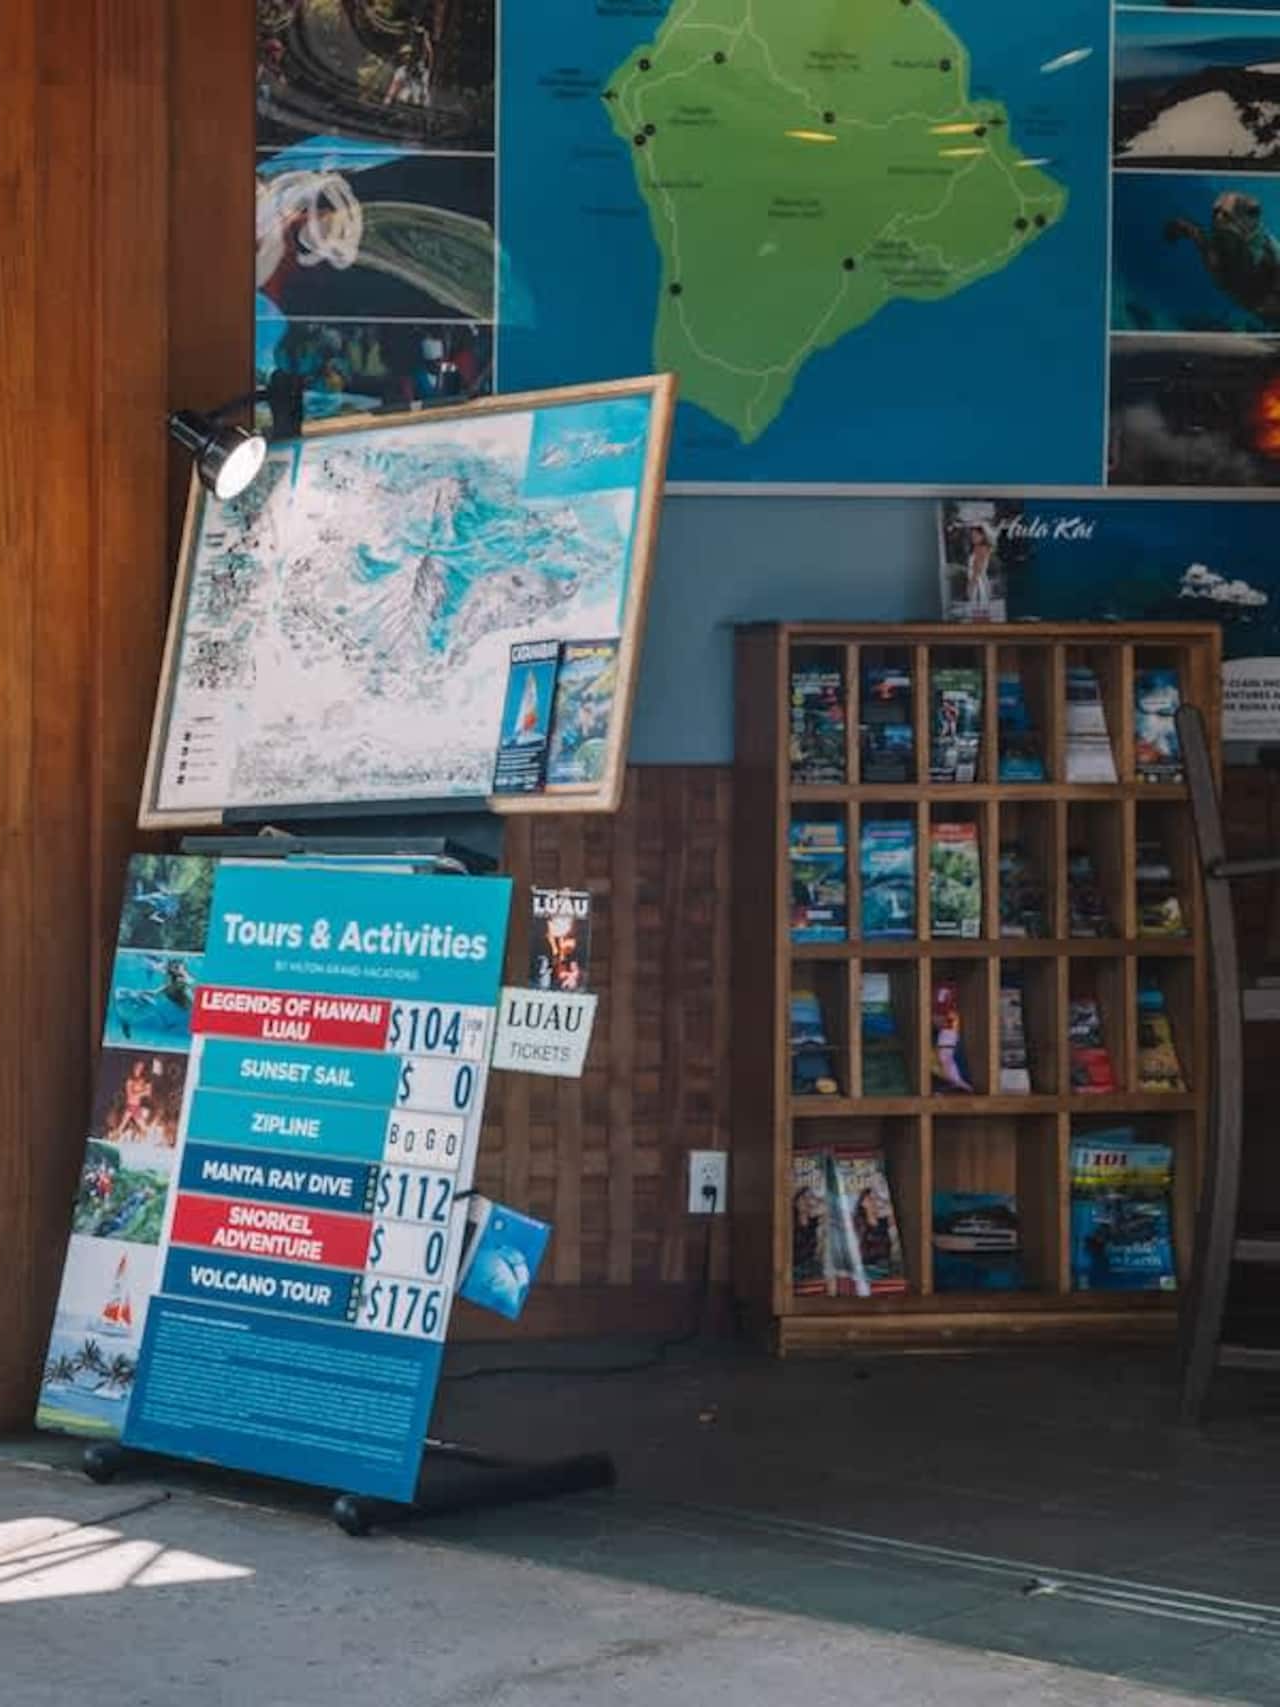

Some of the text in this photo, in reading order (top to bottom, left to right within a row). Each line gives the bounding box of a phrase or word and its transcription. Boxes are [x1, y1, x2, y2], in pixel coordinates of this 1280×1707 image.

[1052, 516, 1097, 540] Kai
[532, 897, 589, 916] LUAU
[223, 913, 489, 961] Tours & Activities
[201, 990, 382, 1025] LEGENDS OF HAWAII
[507, 1001, 584, 1033] LUAU
[262, 1019, 312, 1040] LUAU
[388, 1004, 461, 1054] $104
[510, 1042, 572, 1063] TICKETS
[240, 1058, 355, 1088] SUNSET SAIL
[399, 1058, 473, 1110] $ 0
[250, 1112, 321, 1138] ZIPLINE
[201, 1159, 353, 1197] MANTA RAY DIVE
[377, 1166, 455, 1223] $112
[228, 1205, 313, 1235] SNORKEL
[212, 1228, 324, 1261] ADVENTURE
[369, 1224, 445, 1276] $ 0
[189, 1265, 333, 1306] VOLCANO TOUR
[366, 1278, 442, 1335] $176
